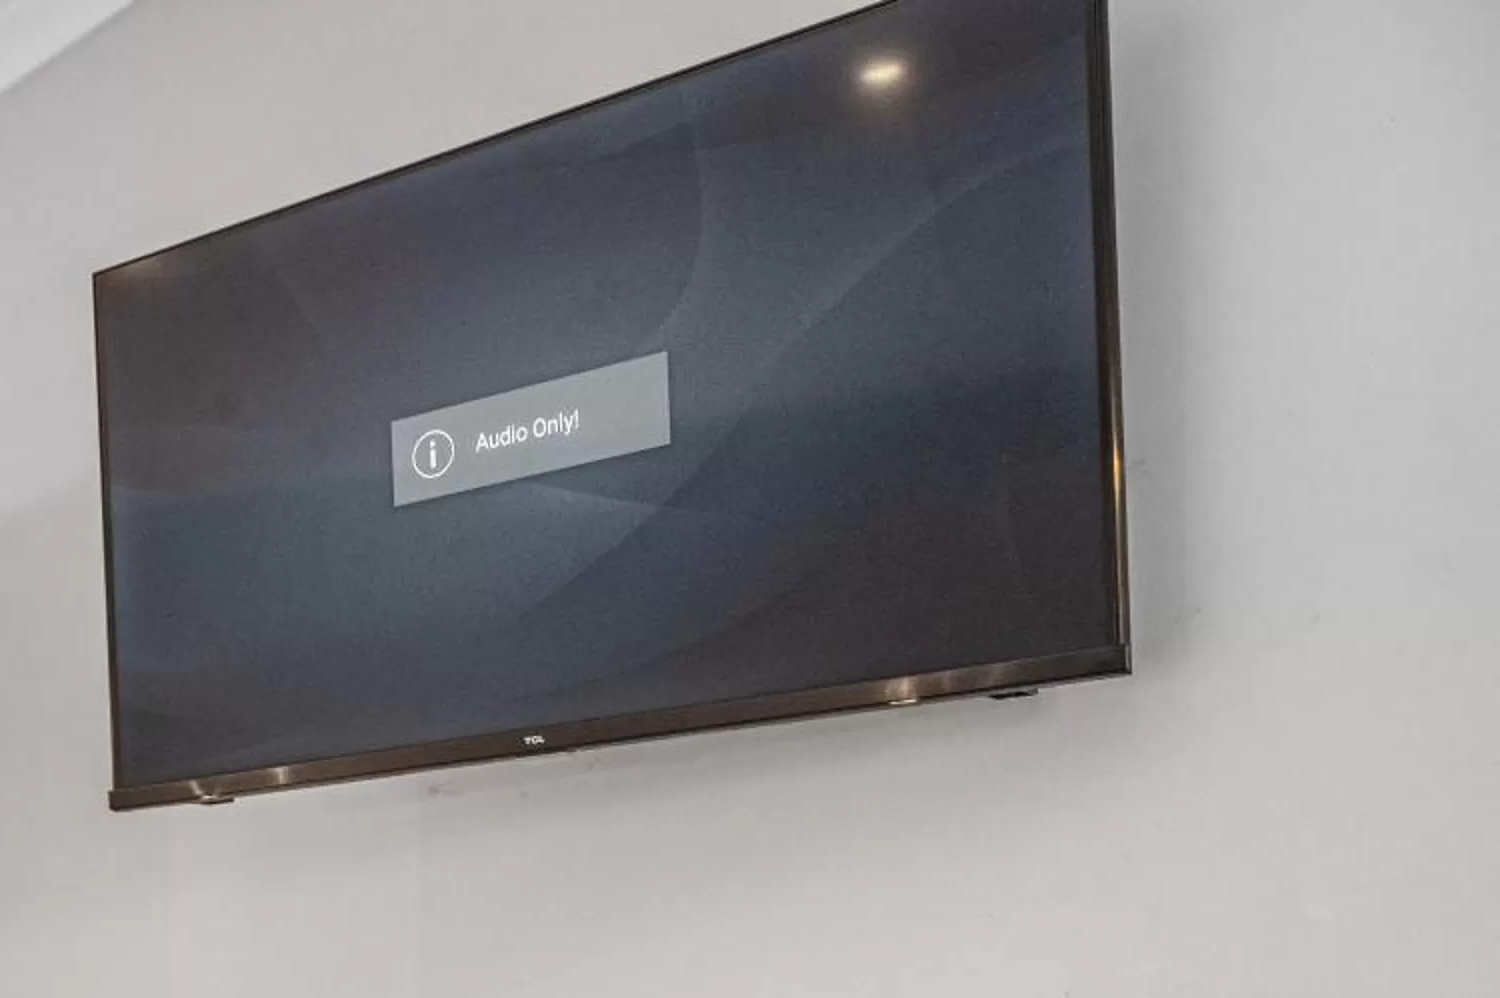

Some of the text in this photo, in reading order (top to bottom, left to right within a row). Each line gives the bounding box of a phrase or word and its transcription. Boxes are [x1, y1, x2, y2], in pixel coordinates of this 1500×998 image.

[475, 408, 580, 453] Audio Only!
[523, 735, 546, 745] TCL
